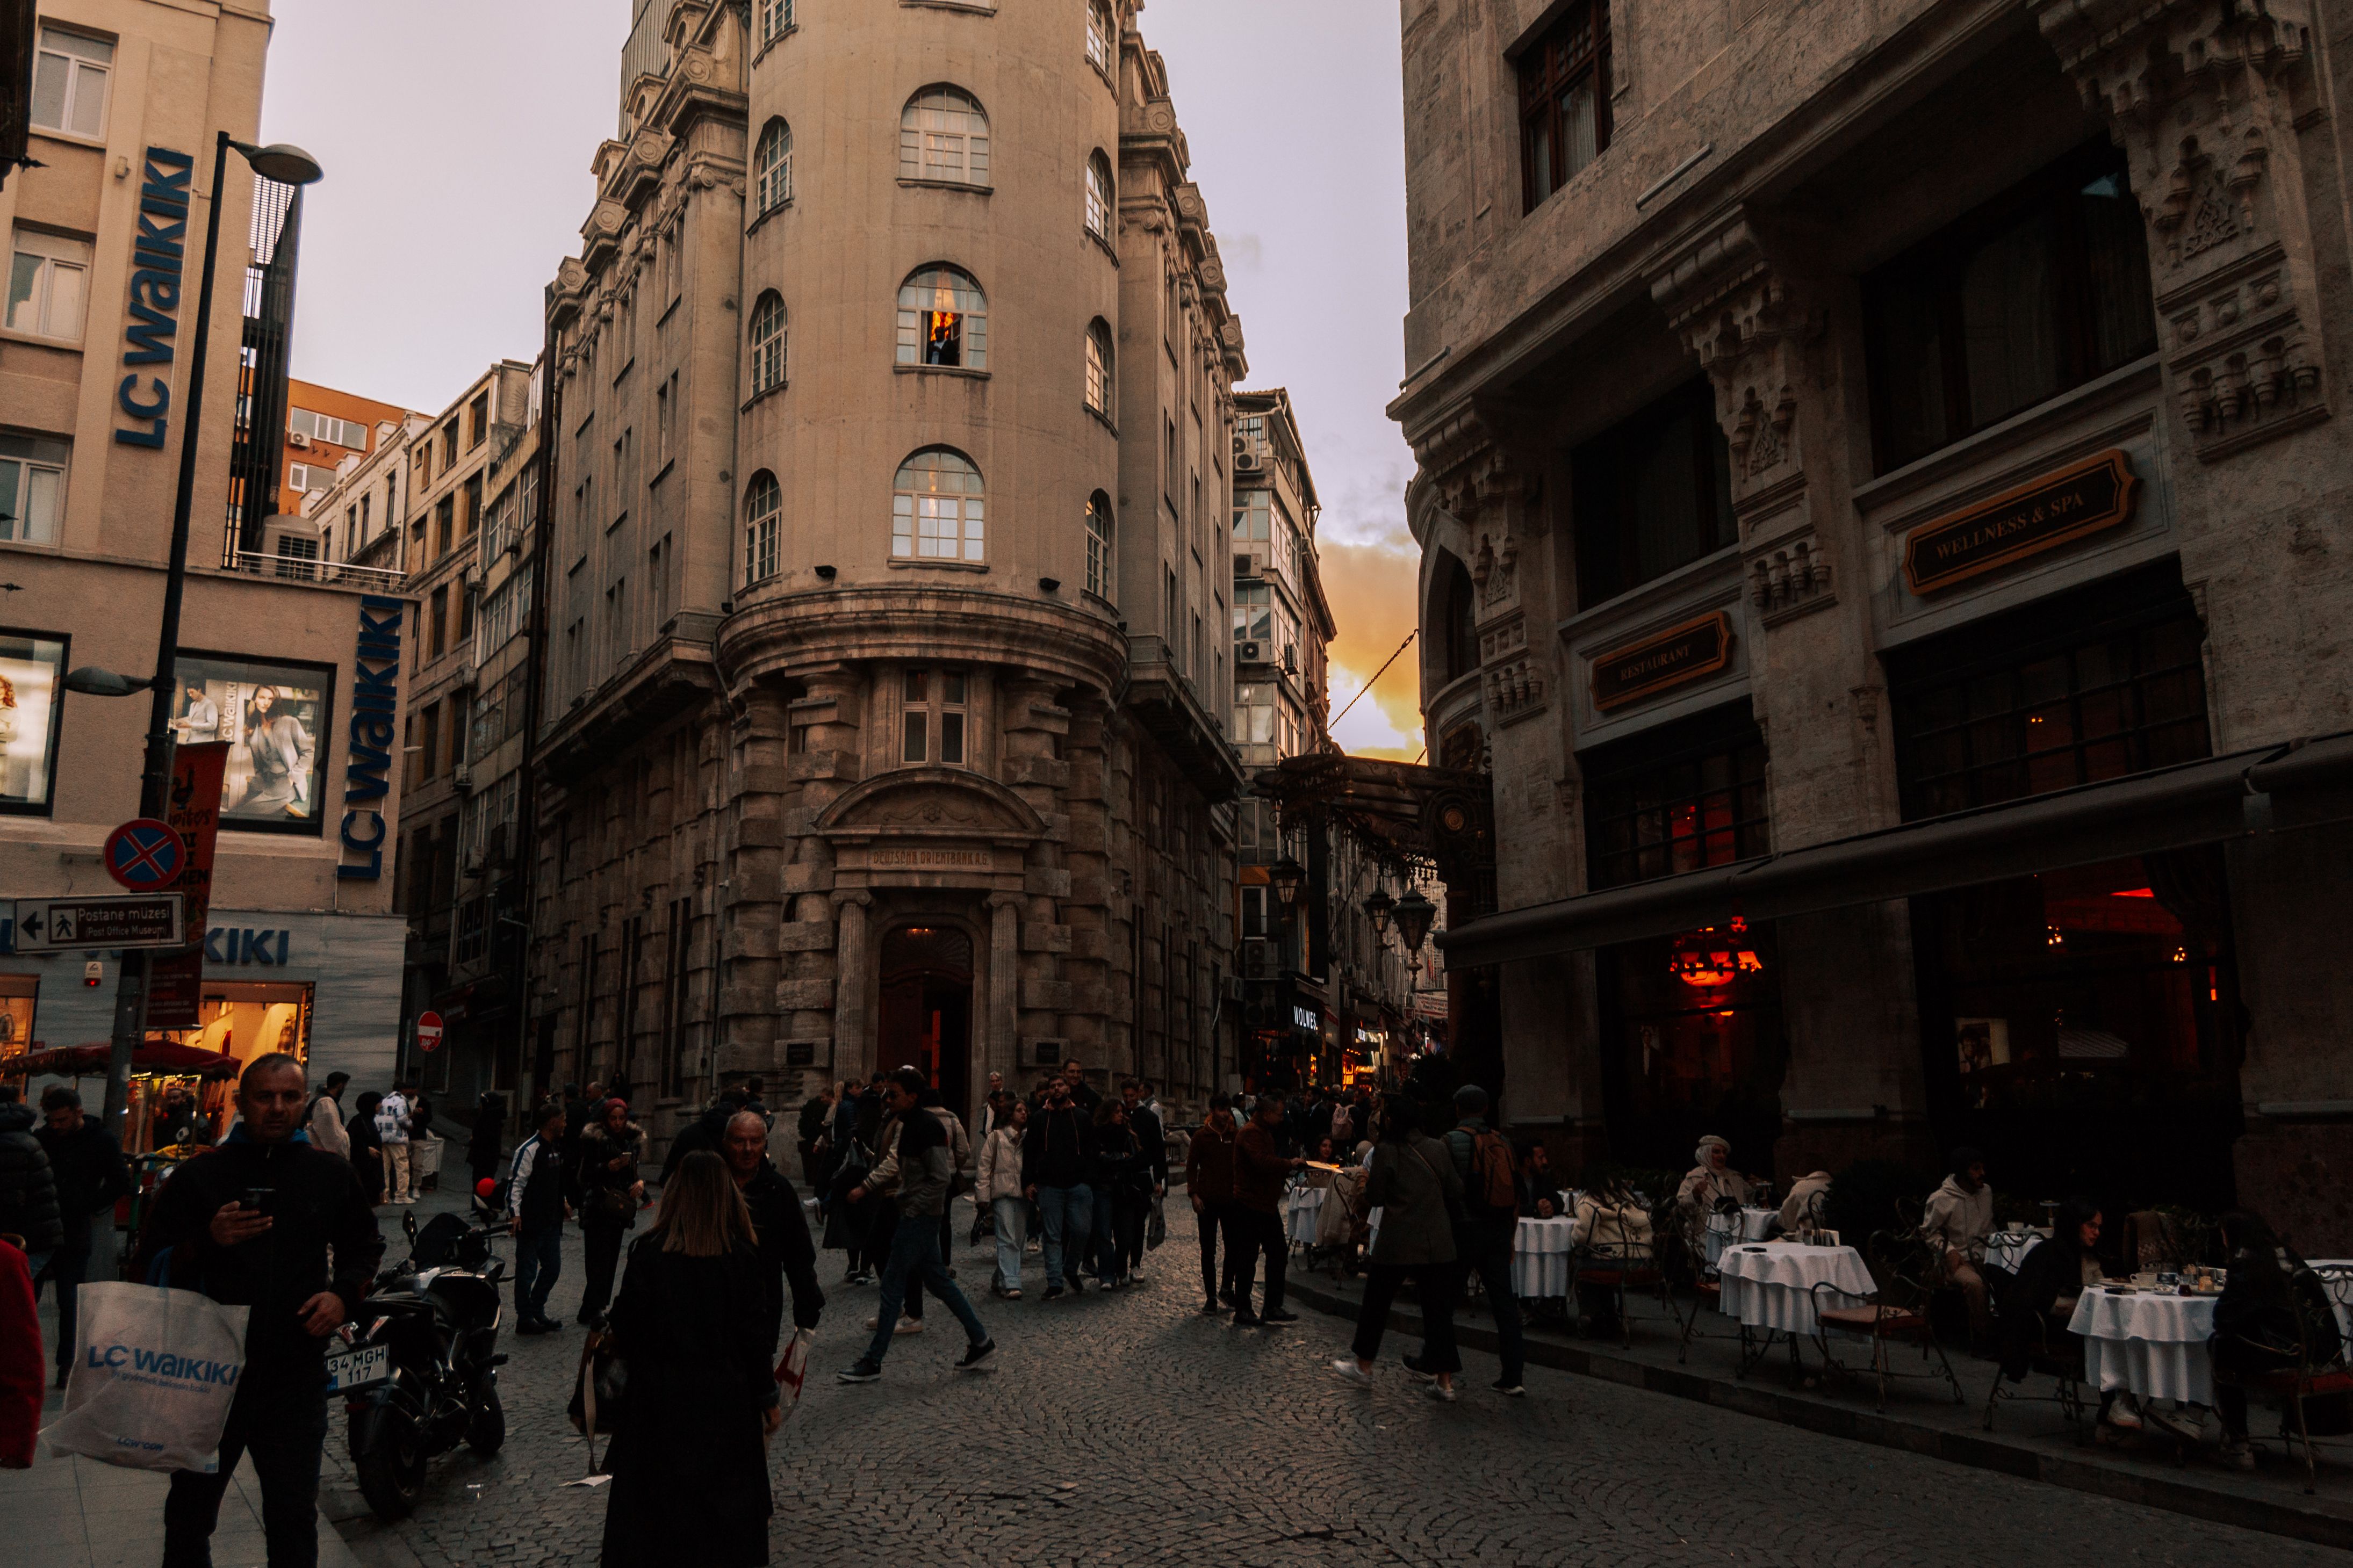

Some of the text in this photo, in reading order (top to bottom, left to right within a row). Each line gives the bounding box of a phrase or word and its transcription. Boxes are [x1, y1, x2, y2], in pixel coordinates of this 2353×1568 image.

[116, 373, 170, 450] LC
[1936, 492, 2085, 559] WELLNESS & SPA
[1620, 644, 1691, 681] RESTAURANT
[337, 810, 386, 878] LC
[874, 851, 918, 864] DEUTSCHE
[920, 851, 973, 865] ORIENTBANK
[78, 906, 170, 922] Postane müzesi
[85, 923, 168, 938] (Post Office Museum)
[88, 1345, 129, 1368] LC
[330, 1347, 385, 1372] 34 MGH
[348, 1365, 372, 1384] 117
